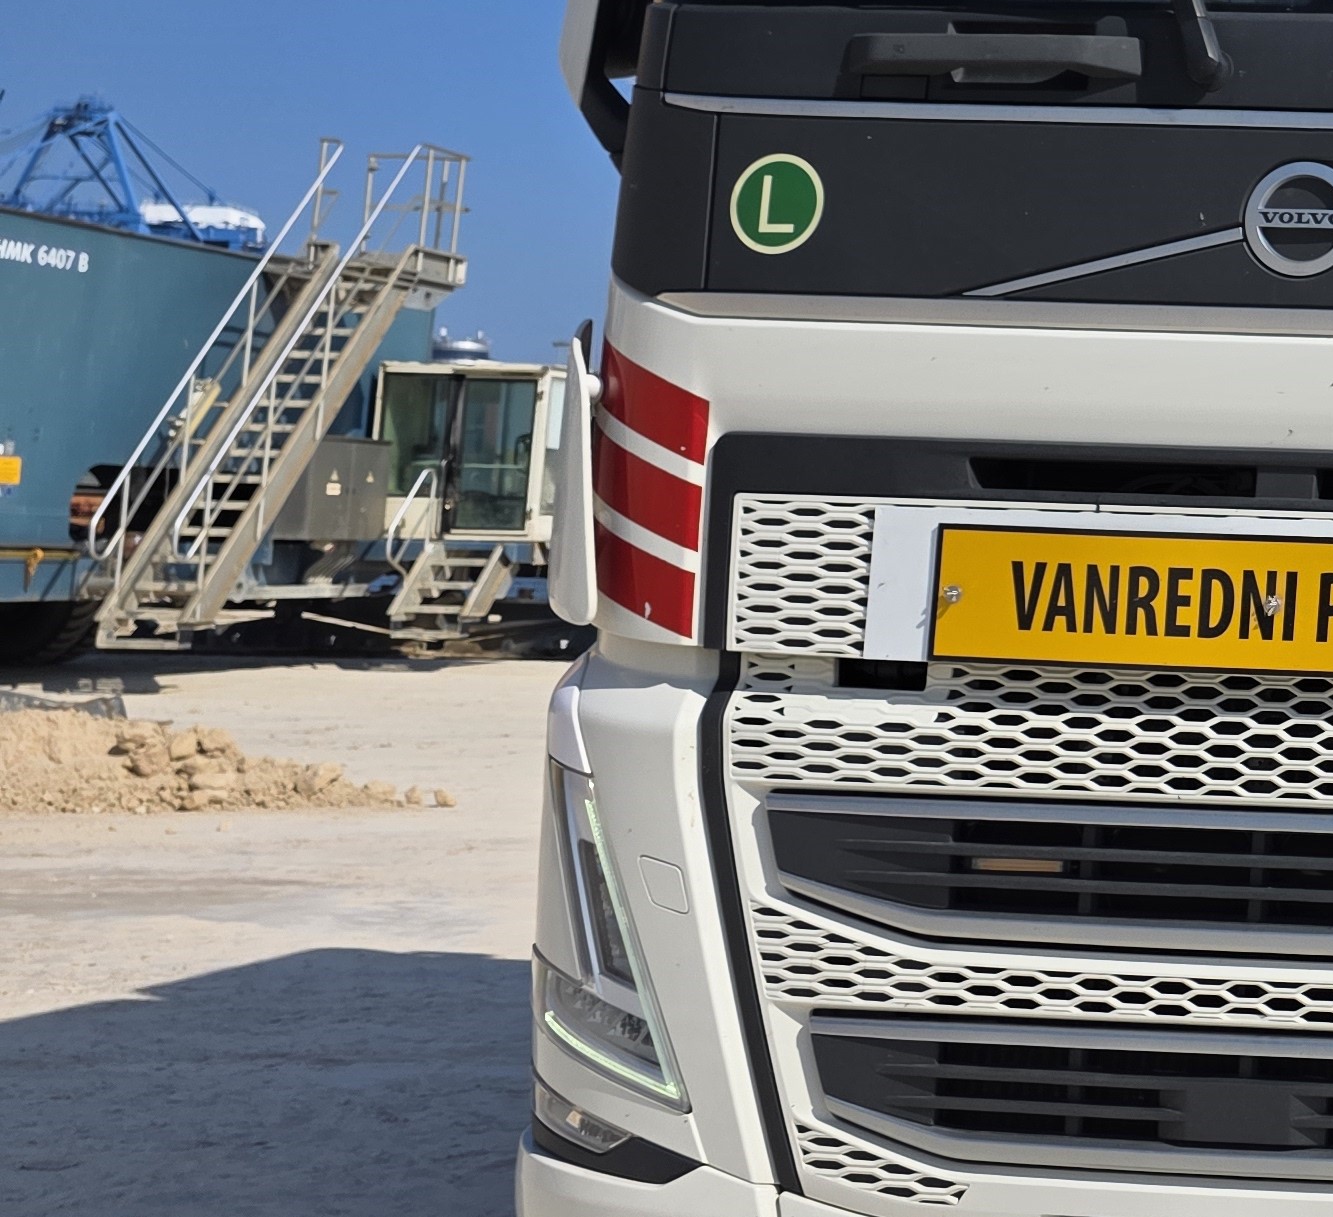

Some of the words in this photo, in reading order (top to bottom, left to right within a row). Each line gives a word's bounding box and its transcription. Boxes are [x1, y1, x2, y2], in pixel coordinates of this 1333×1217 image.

[758, 175, 795, 233] L
[37, 245, 76, 271] 6407
[78, 251, 90, 273] B
[1011, 560, 1298, 641] VANREDNI
